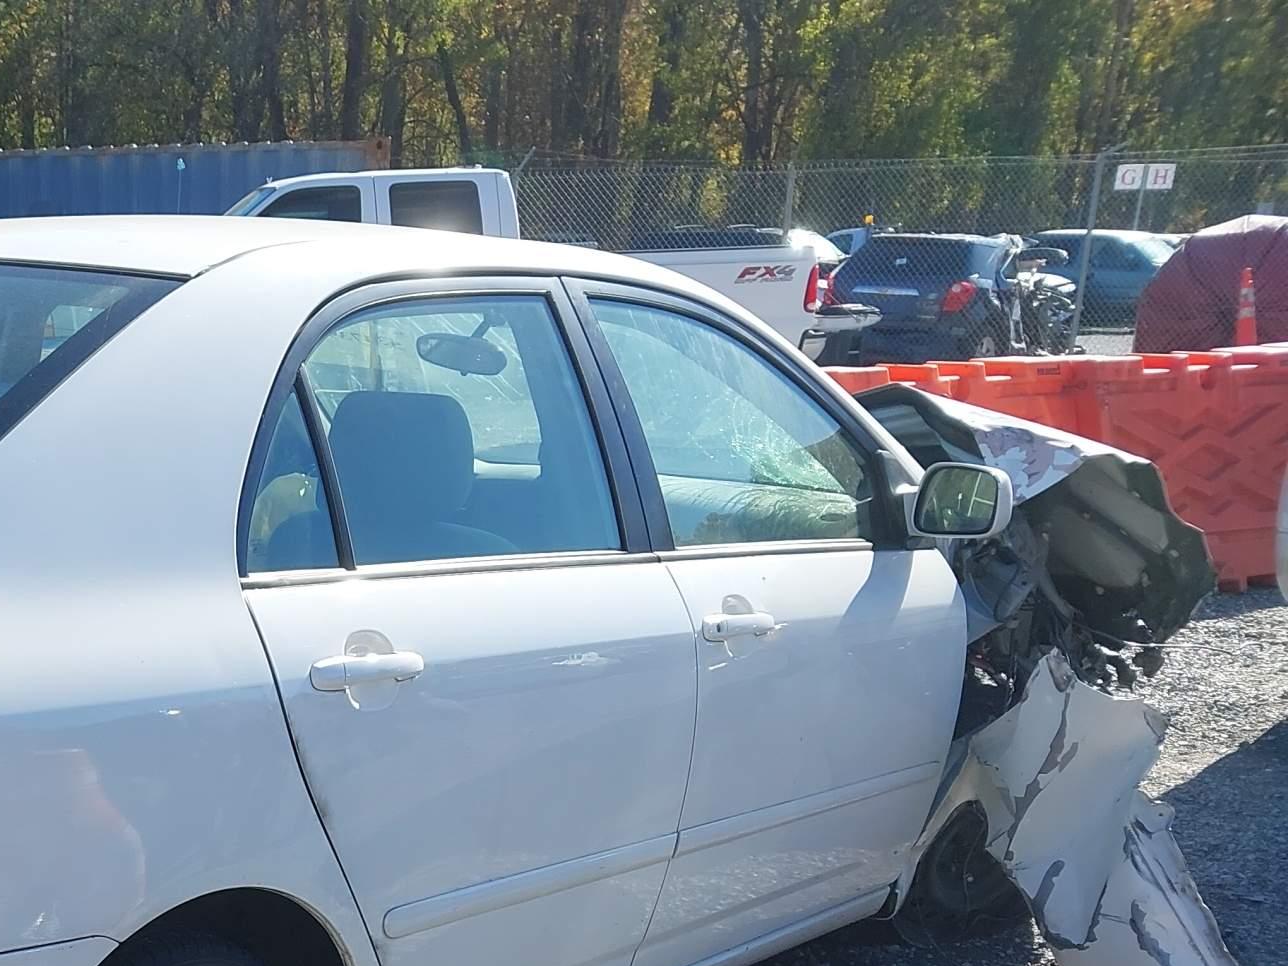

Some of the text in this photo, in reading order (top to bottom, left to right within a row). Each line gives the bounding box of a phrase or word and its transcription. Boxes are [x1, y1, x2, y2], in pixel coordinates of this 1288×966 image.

[1121, 168, 1137, 186] G
[1152, 168, 1169, 185] H
[737, 264, 797, 279] FX4
